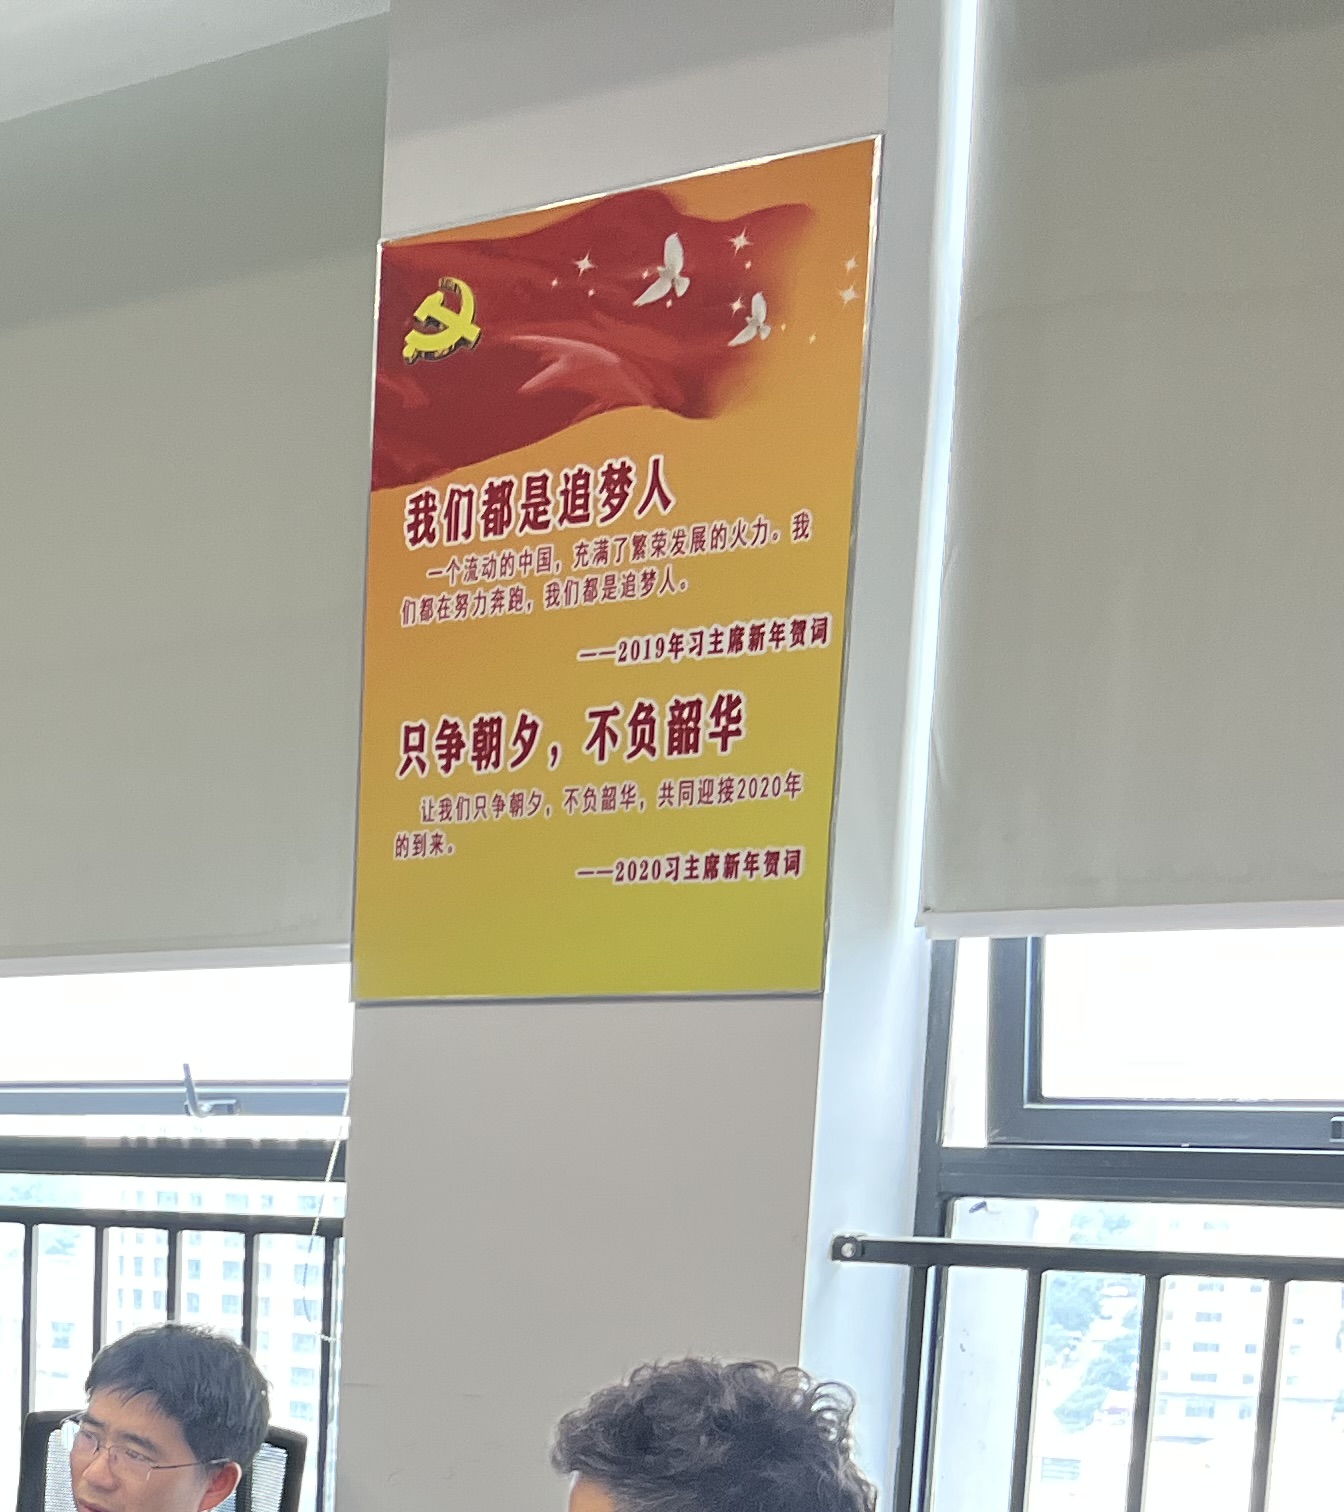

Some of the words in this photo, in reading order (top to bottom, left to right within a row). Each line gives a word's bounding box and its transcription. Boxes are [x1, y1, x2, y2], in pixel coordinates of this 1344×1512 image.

[406, 457, 674, 546] 我们都是追梦人
[400, 569, 690, 627] 们都在努力奔跑，我们都是追梦人。
[398, 693, 744, 778] 只争朝夕，不负韶华
[393, 832, 456, 859] 的到来。
